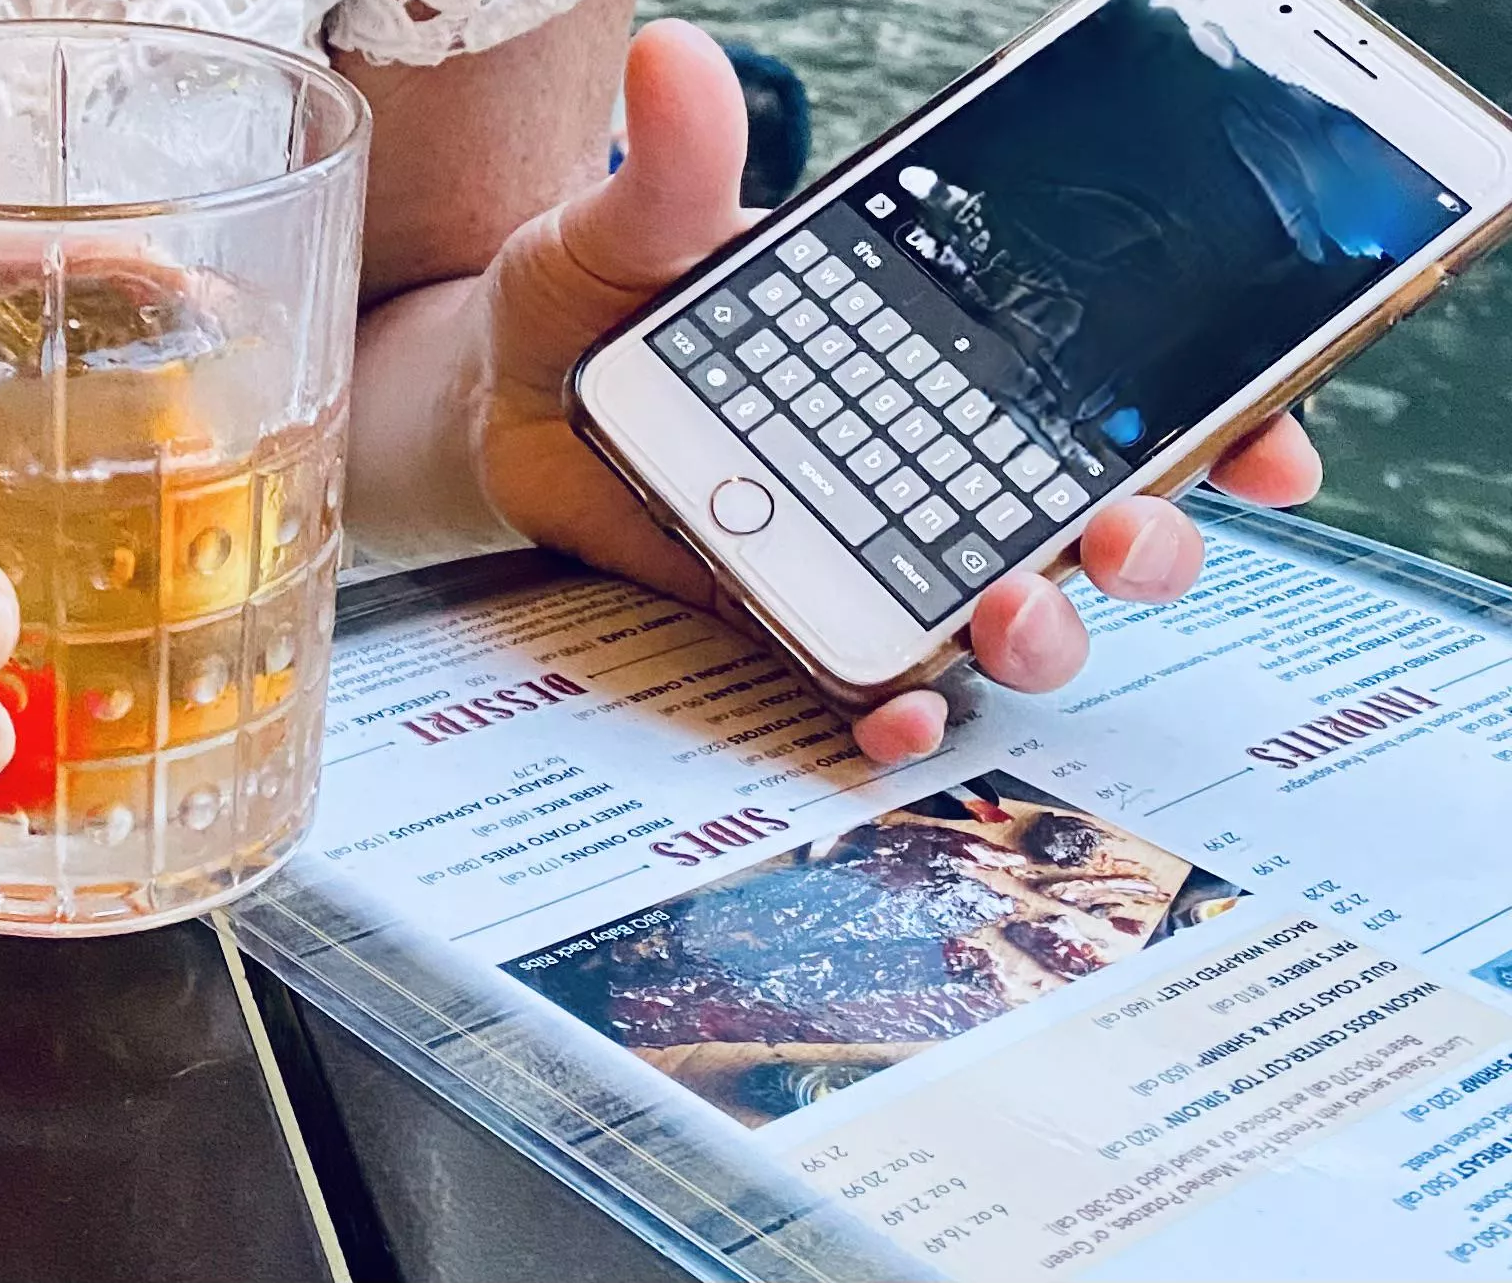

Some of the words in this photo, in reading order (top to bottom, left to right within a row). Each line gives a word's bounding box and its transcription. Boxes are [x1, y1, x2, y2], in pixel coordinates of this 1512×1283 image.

[853, 241, 882, 268] the
[954, 337, 970, 351] a
[792, 244, 810, 261] q
[819, 268, 840, 285] w
[848, 295, 865, 310] e
[876, 323, 892, 334] r
[906, 349, 921, 363] t
[929, 376, 951, 391] y
[962, 403, 980, 419] u
[1048, 489, 1070, 506] p
[766, 287, 782, 301] a
[794, 313, 810, 327] s
[821, 339, 842, 354] d
[851, 366, 869, 379] f
[874, 394, 896, 411] g
[905, 418, 924, 437] h
[932, 448, 954, 465] j
[964, 476, 984, 495] k
[997, 508, 1014, 521] l
[753, 343, 770, 358] z
[780, 370, 797, 385] x
[808, 398, 825, 412] c
[837, 424, 854, 439] v
[863, 450, 883, 468] b
[892, 481, 910, 497] n
[919, 507, 943, 529] m
[671, 332, 695, 354] 123
[797, 461, 834, 496] space
[891, 554, 930, 593] return
[1346, 600, 1398, 620] CHICKEN
[1387, 617, 1441, 639] COUNTRY
[1355, 636, 1392, 651] FRIED
[1433, 634, 1486, 655] CHICKEN
[1319, 648, 1360, 665] STEAK
[1403, 653, 1439, 668] FRIED
[464, 674, 497, 686] 9.00
[1353, 665, 1407, 688] CHICKEN
[626, 681, 683, 702] CHEESE
[1311, 694, 1334, 705] cal)
[351, 690, 451, 725] CHEESECAKE
[400, 673, 588, 743] DESSERT
[571, 709, 598, 720] cal)
[1245, 687, 1439, 769] FAVORITES
[672, 751, 698, 763] cal)
[697, 740, 731, 754] (320
[512, 763, 544, 778] 2.79
[544, 756, 566, 766] for
[1050, 761, 1087, 777] 18.29
[508, 767, 584, 796] UPGRADE
[569, 783, 613, 801] HERB
[734, 783, 761, 796] cal)
[483, 793, 510, 805] TO
[532, 798, 571, 815] RICE
[388, 802, 483, 838] ASPARAGUS
[499, 811, 535, 827] (480
[589, 800, 643, 822] SWEET
[471, 823, 500, 837] cal)
[527, 820, 591, 845] POTATO
[626, 817, 673, 837] FRIED
[648, 807, 790, 866] SIDES
[353, 834, 390, 850] (150
[560, 835, 627, 862] ONIONS
[1202, 832, 1240, 851] 27.99
[323, 846, 353, 859] cal)
[480, 843, 528, 862] FRIES
[445, 858, 482, 875] (380
[527, 858, 563, 875] (170
[1251, 855, 1290, 875] 21.99
[417, 871, 446, 885] cal)
[498, 871, 528, 885] cal)
[1301, 880, 1341, 900] 20.29
[1329, 893, 1369, 914] 21.29
[628, 910, 670, 928] BBQ
[1362, 909, 1402, 930] 20.79
[589, 924, 634, 943] Baby
[1262, 921, 1317, 948] BACON
[552, 939, 596, 958] Back
[1315, 940, 1358, 961] PAT'S
[518, 954, 558, 971] Ribs
[1195, 945, 1268, 980] WRAPPED
[1358, 961, 1398, 983] GULF
[1232, 984, 1268, 1003] (810
[1310, 979, 1361, 1006] COAST
[1379, 982, 1440, 1013] WAGON
[1119, 998, 1155, 1017] (460
[1207, 998, 1237, 1014] cal)
[1264, 1003, 1315, 1029] STEAK
[1092, 1012, 1122, 1029] cal)
[1250, 1026, 1270, 1036] &
[1342, 1010, 1386, 1033] BOSS
[1257, 1030, 1348, 1078] CENTER-CUT
[1376, 1035, 1423, 1058] Beans
[1427, 1036, 1472, 1058] Lunch
[1156, 1062, 1194, 1084] (650
[1386, 1056, 1435, 1080] Steaks
[1458, 1059, 1512, 1093] SHRIMP
[1129, 1079, 1161, 1096] cal)
[1227, 1075, 1263, 1094] TOP
[1303, 1080, 1334, 1098] cal)
[1344, 1078, 1392, 1105] served
[1278, 1093, 1310, 1112] and
[1426, 1088, 1463, 1109] (320
[1234, 1107, 1282, 1133] choice
[1315, 1101, 1349, 1119] with
[1401, 1104, 1432, 1122] cal)
[1124, 1123, 1164, 1146] (420
[1217, 1130, 1238, 1145] of
[1269, 1117, 1324, 1145] French
[1444, 1117, 1498, 1147] chicken
[1097, 1140, 1130, 1160] cal)
[1206, 1139, 1220, 1147] a
[799, 1145, 848, 1172] 21.99
[909, 1149, 935, 1163] 10
[1168, 1145, 1211, 1170] salad
[1451, 1142, 1512, 1179] BREAST
[839, 1171, 888, 1198] 20.99
[949, 1178, 967, 1189] 6
[1135, 1164, 1176, 1188] (add
[1175, 1163, 1239, 1195] Mashed
[1419, 1172, 1458, 1196] (560
[991, 1204, 1009, 1215] 6
[1075, 1185, 1141, 1220] 100-380
[1393, 1190, 1425, 1210] cal)
[880, 1197, 929, 1225] 21.49
[1105, 1192, 1184, 1231] Potatoes,
[922, 1225, 970, 1253] 16.49
[1090, 1229, 1110, 1243] or
[1472, 1223, 1512, 1248] (560
[1041, 1240, 1095, 1269] Green
[1446, 1242, 1479, 1263] cal)
